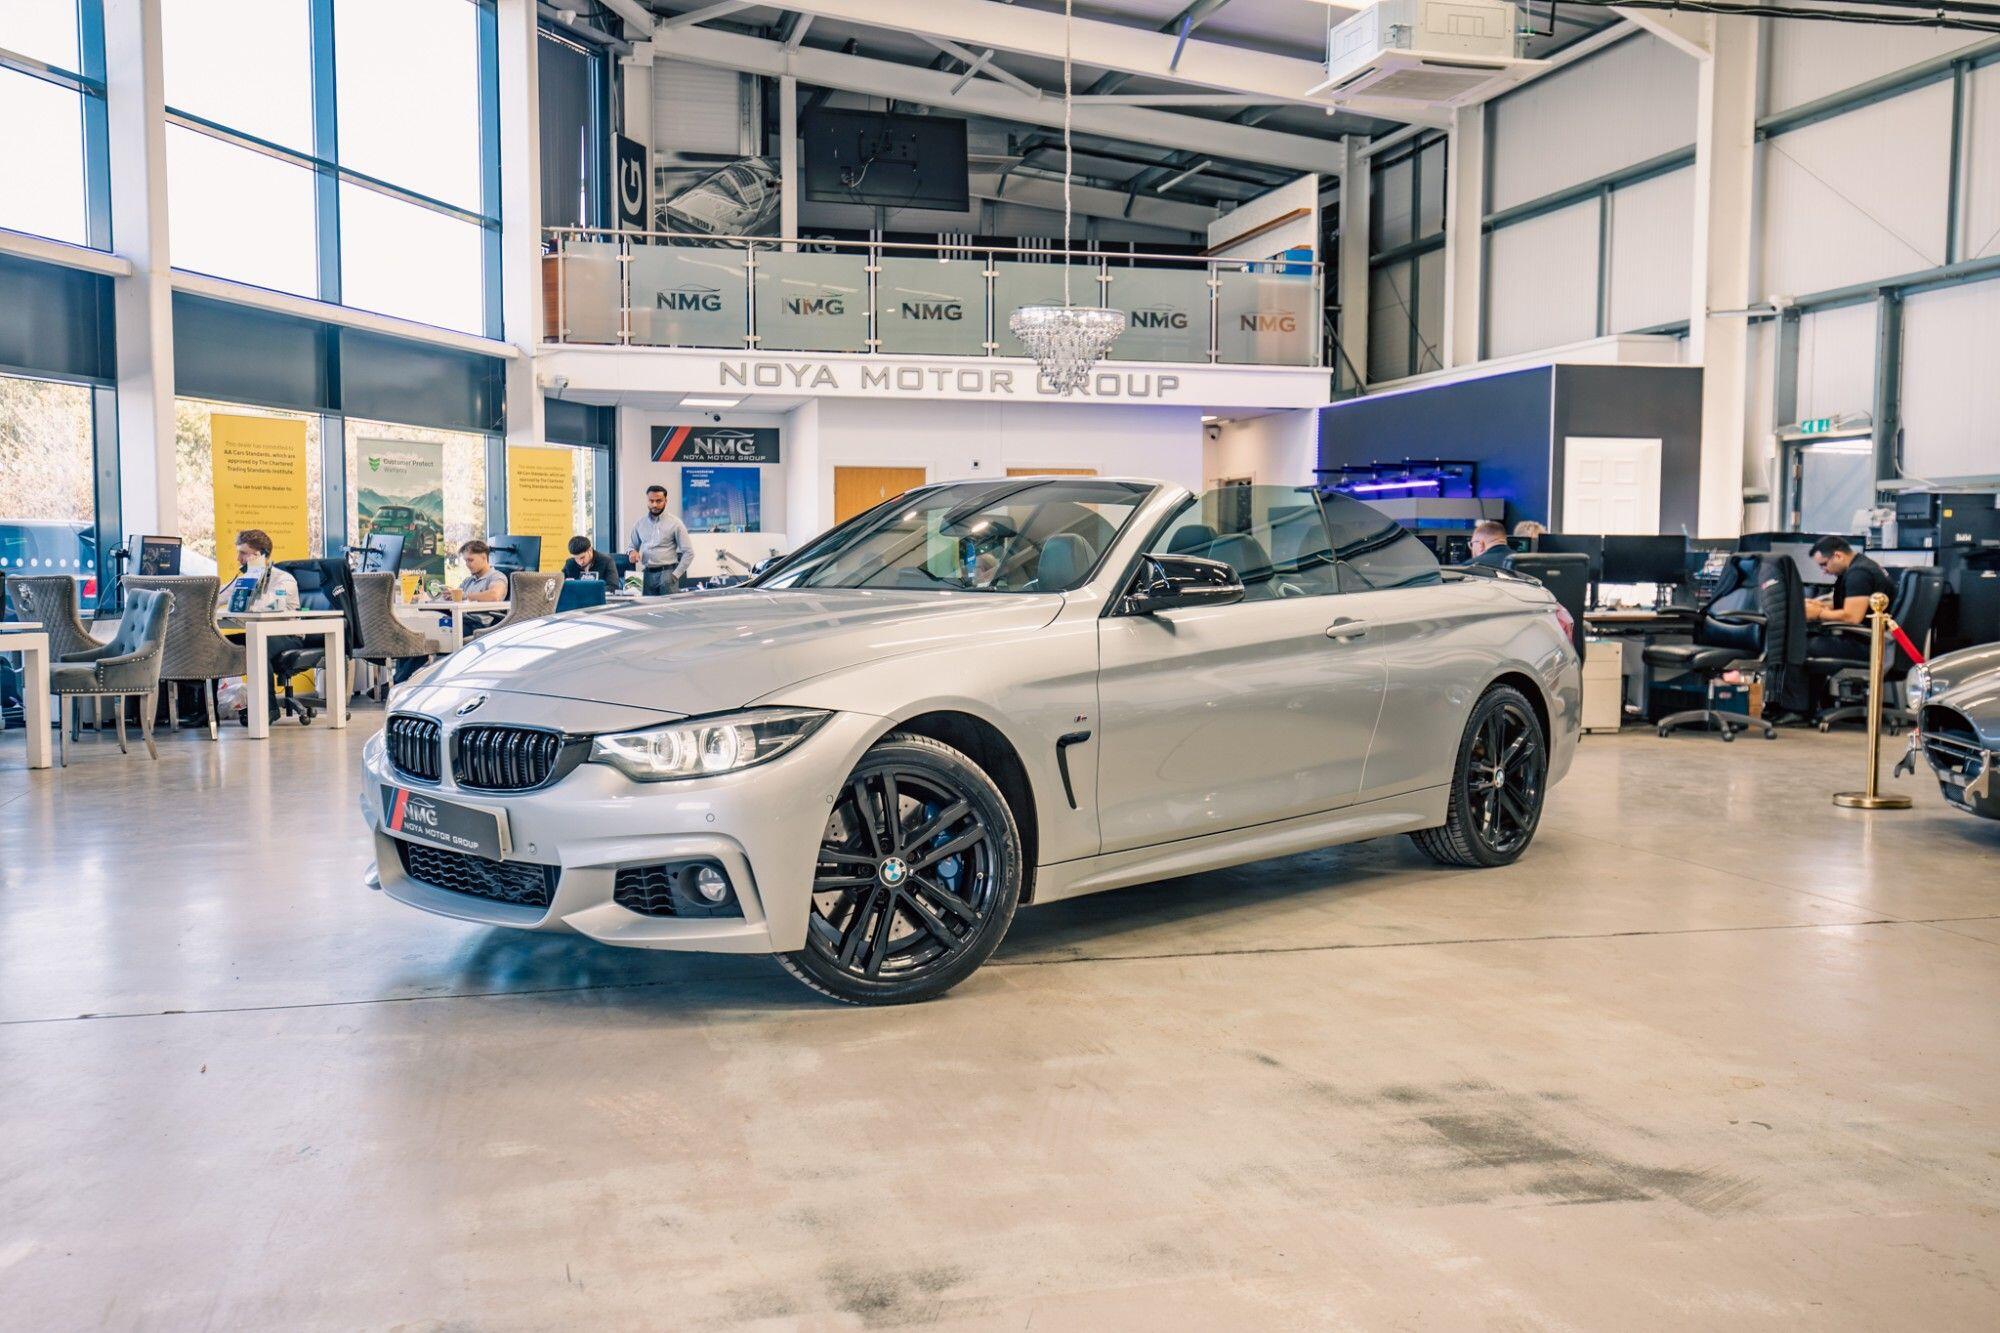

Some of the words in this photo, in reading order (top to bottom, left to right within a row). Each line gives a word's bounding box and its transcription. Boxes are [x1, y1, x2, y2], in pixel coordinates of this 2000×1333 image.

[656, 291, 722, 312] NMG
[781, 293, 845, 316] NMG
[901, 302, 963, 321] NMG
[1131, 310, 1189, 329] NMG
[1240, 313, 1296, 332] NMG
[719, 361, 839, 389] NOYA
[861, 365, 1014, 394] MOTOR
[694, 438, 755, 455] NMG
[383, 458, 411, 466] Customer
[412, 460, 434, 468] Protect
[401, 801, 438, 826] NMG
[404, 821, 424, 834] NOYA
[425, 828, 451, 841] MOTOR
[452, 836, 479, 849] GROUP
